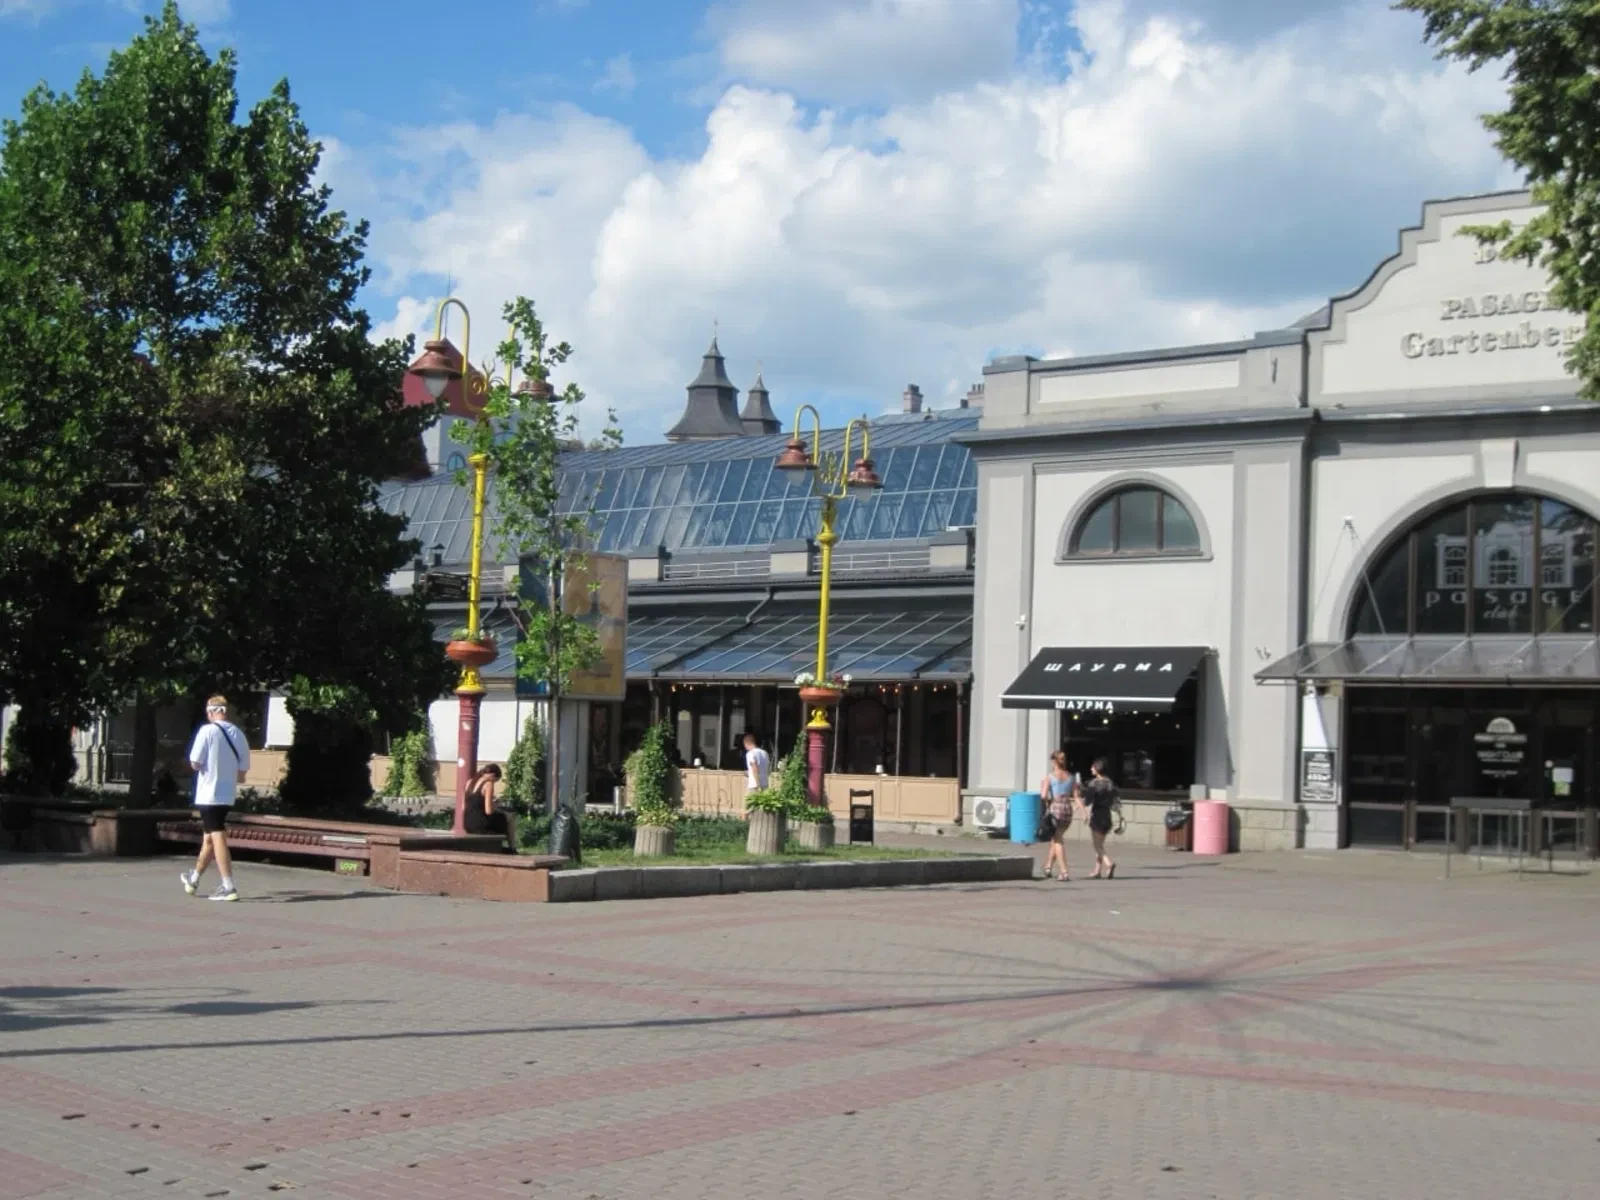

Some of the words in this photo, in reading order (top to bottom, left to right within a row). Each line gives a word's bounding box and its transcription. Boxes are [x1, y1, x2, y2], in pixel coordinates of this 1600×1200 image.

[1400, 320, 1586, 360] Gartenber
[1043, 662, 1173, 673] ШАУРМА
[1054, 699, 1114, 710] ШАУРМА
